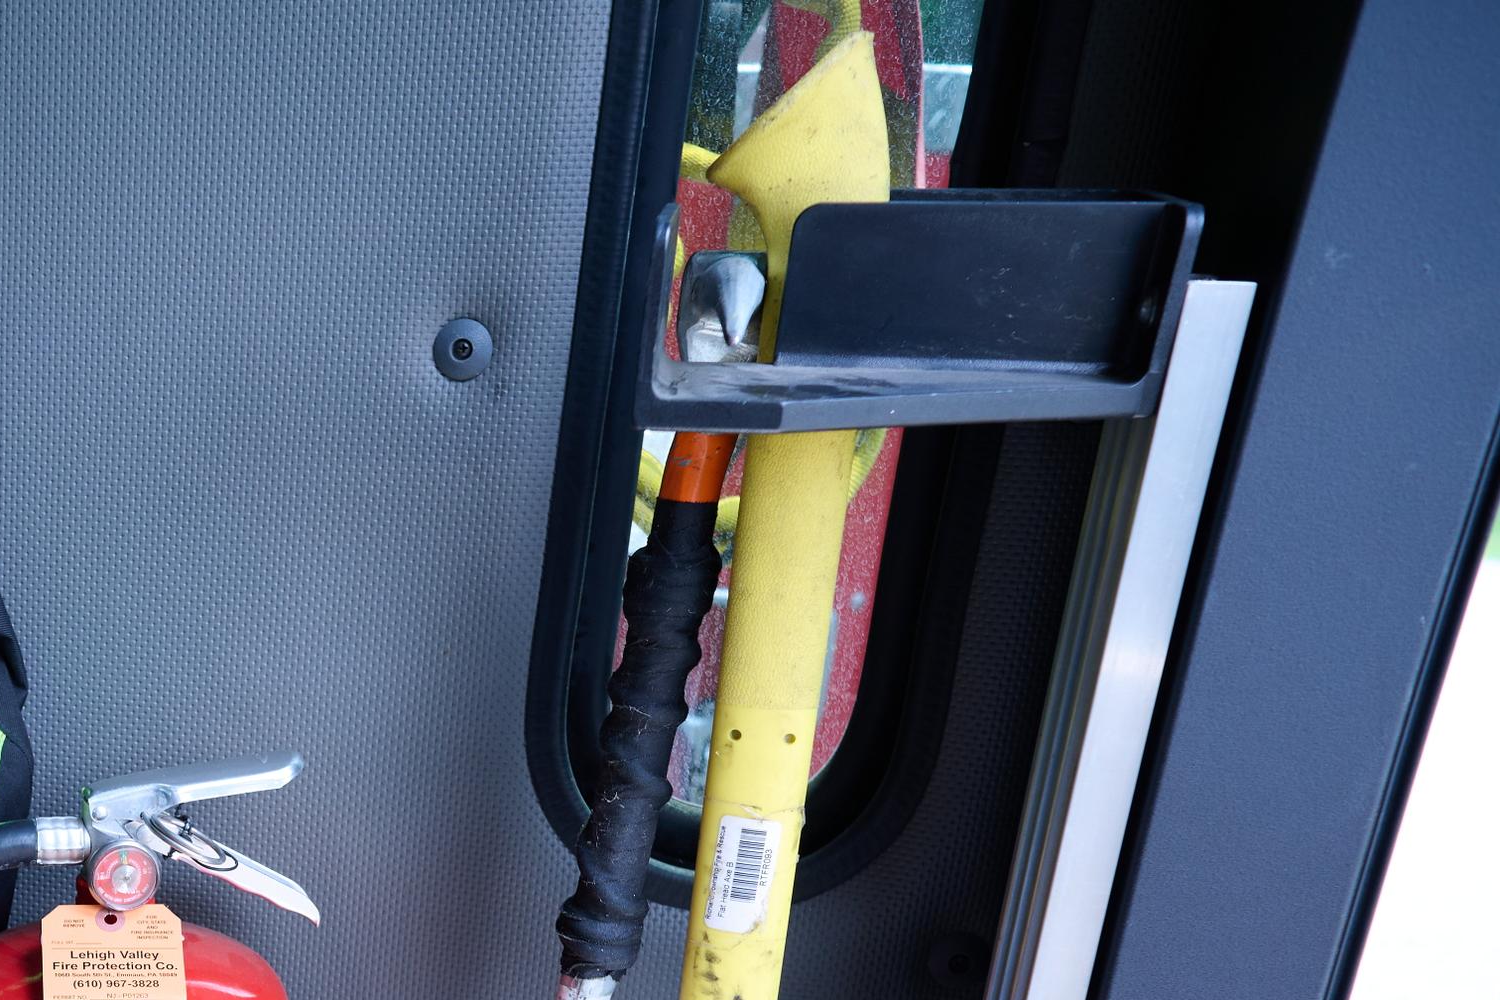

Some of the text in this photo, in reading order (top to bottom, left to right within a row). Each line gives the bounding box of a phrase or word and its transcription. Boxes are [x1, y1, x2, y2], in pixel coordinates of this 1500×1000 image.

[717, 825, 727, 848] Rescue
[759, 849, 772, 887] RTFR093
[718, 905, 727, 918] Flat
[724, 870, 733, 882] Axe
[70, 950, 159, 960] Lehigh Valley
[52, 961, 178, 970] Fire Protection Co.
[73, 979, 160, 989] (610) 967-3828
